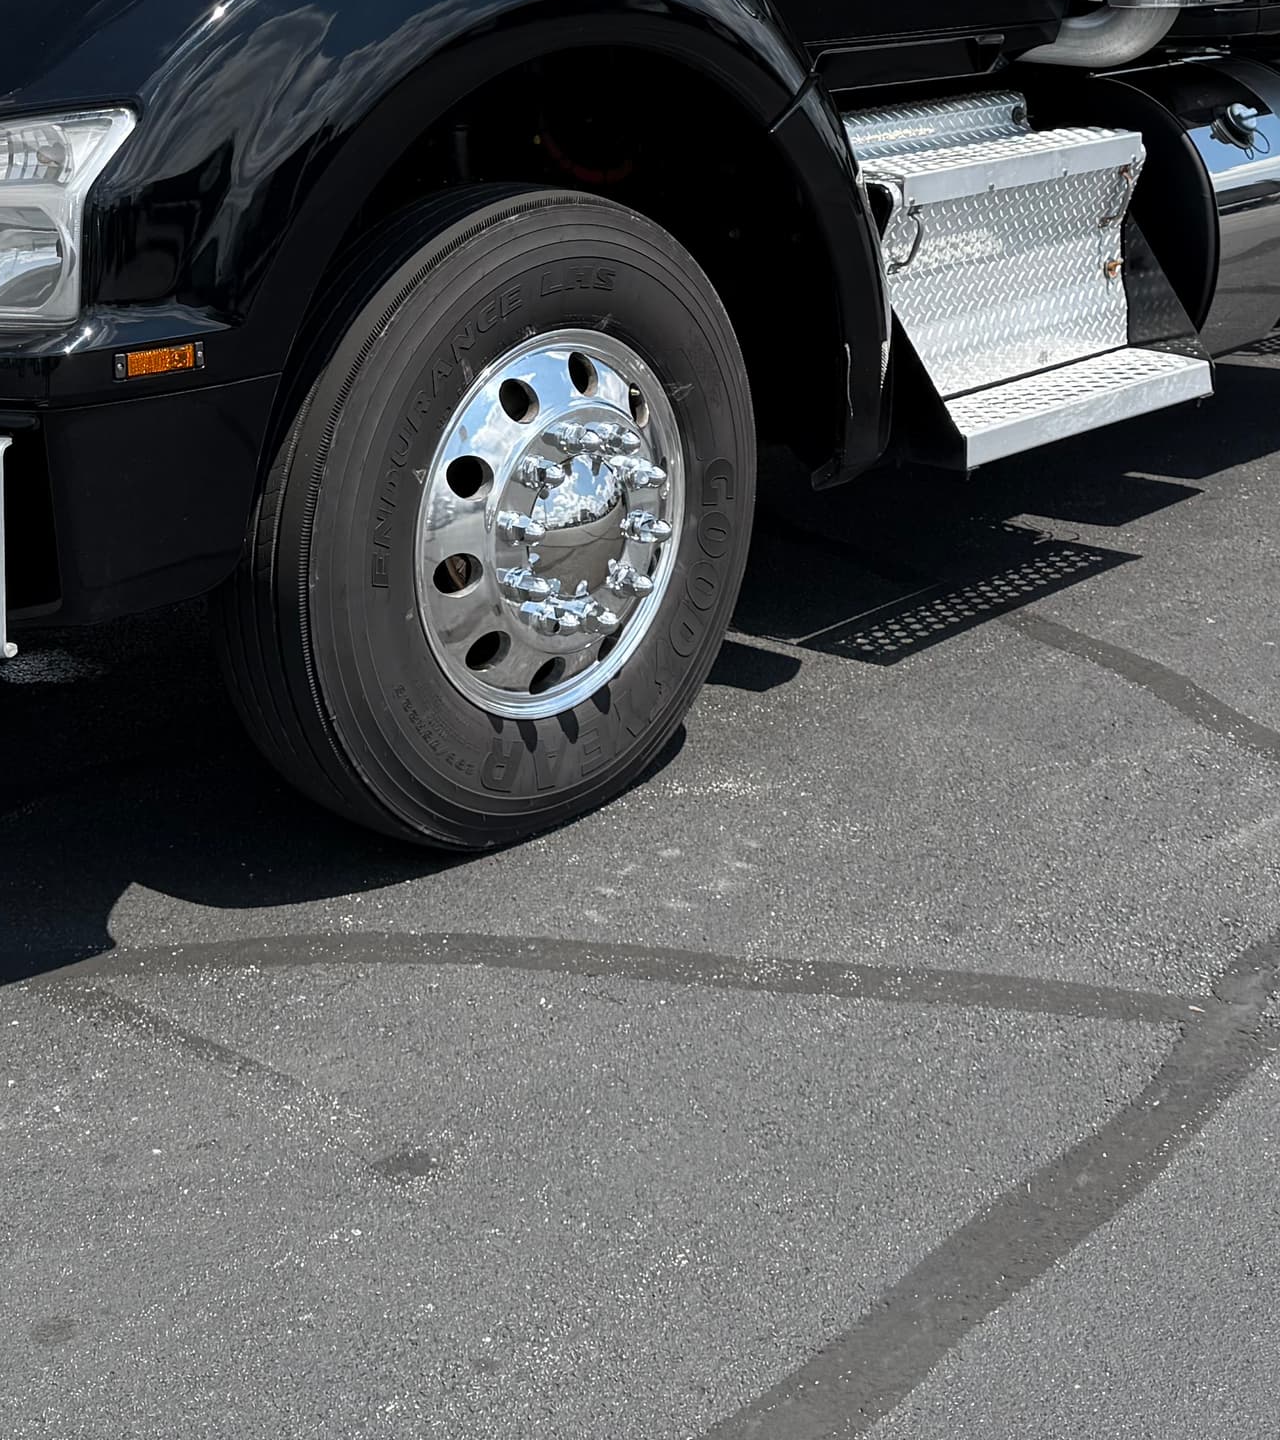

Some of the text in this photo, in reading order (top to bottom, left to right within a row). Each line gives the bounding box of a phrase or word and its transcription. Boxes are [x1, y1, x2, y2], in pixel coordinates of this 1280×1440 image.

[371, 265, 617, 589] ENDURANCE LHS
[478, 458, 736, 795] GOODYEAR
